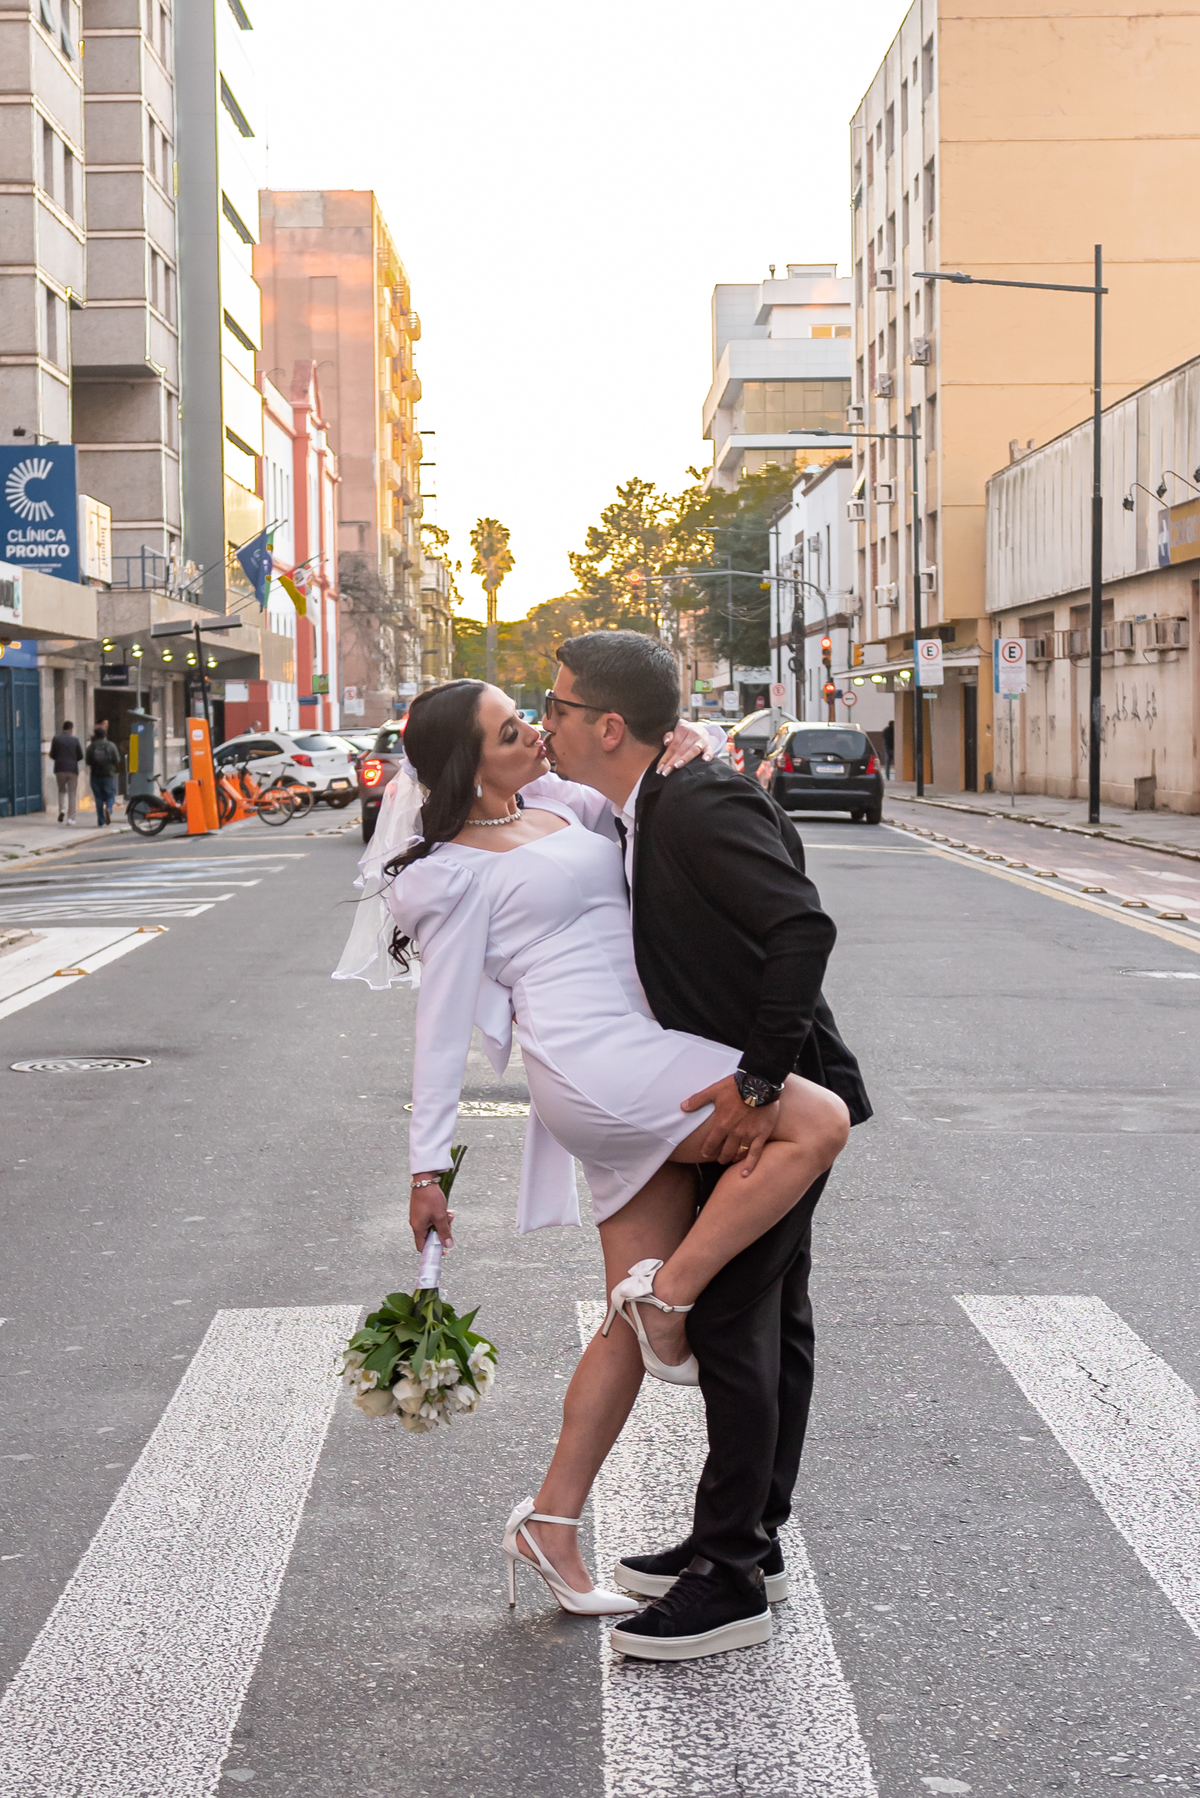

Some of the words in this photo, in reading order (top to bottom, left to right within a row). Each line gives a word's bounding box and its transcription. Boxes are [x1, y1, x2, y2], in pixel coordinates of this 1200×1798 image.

[7, 526, 67, 543] CLÍNICA
[5, 543, 70, 558] PRONTO
[926, 645, 934, 657] E
[1008, 645, 1017, 659] E
